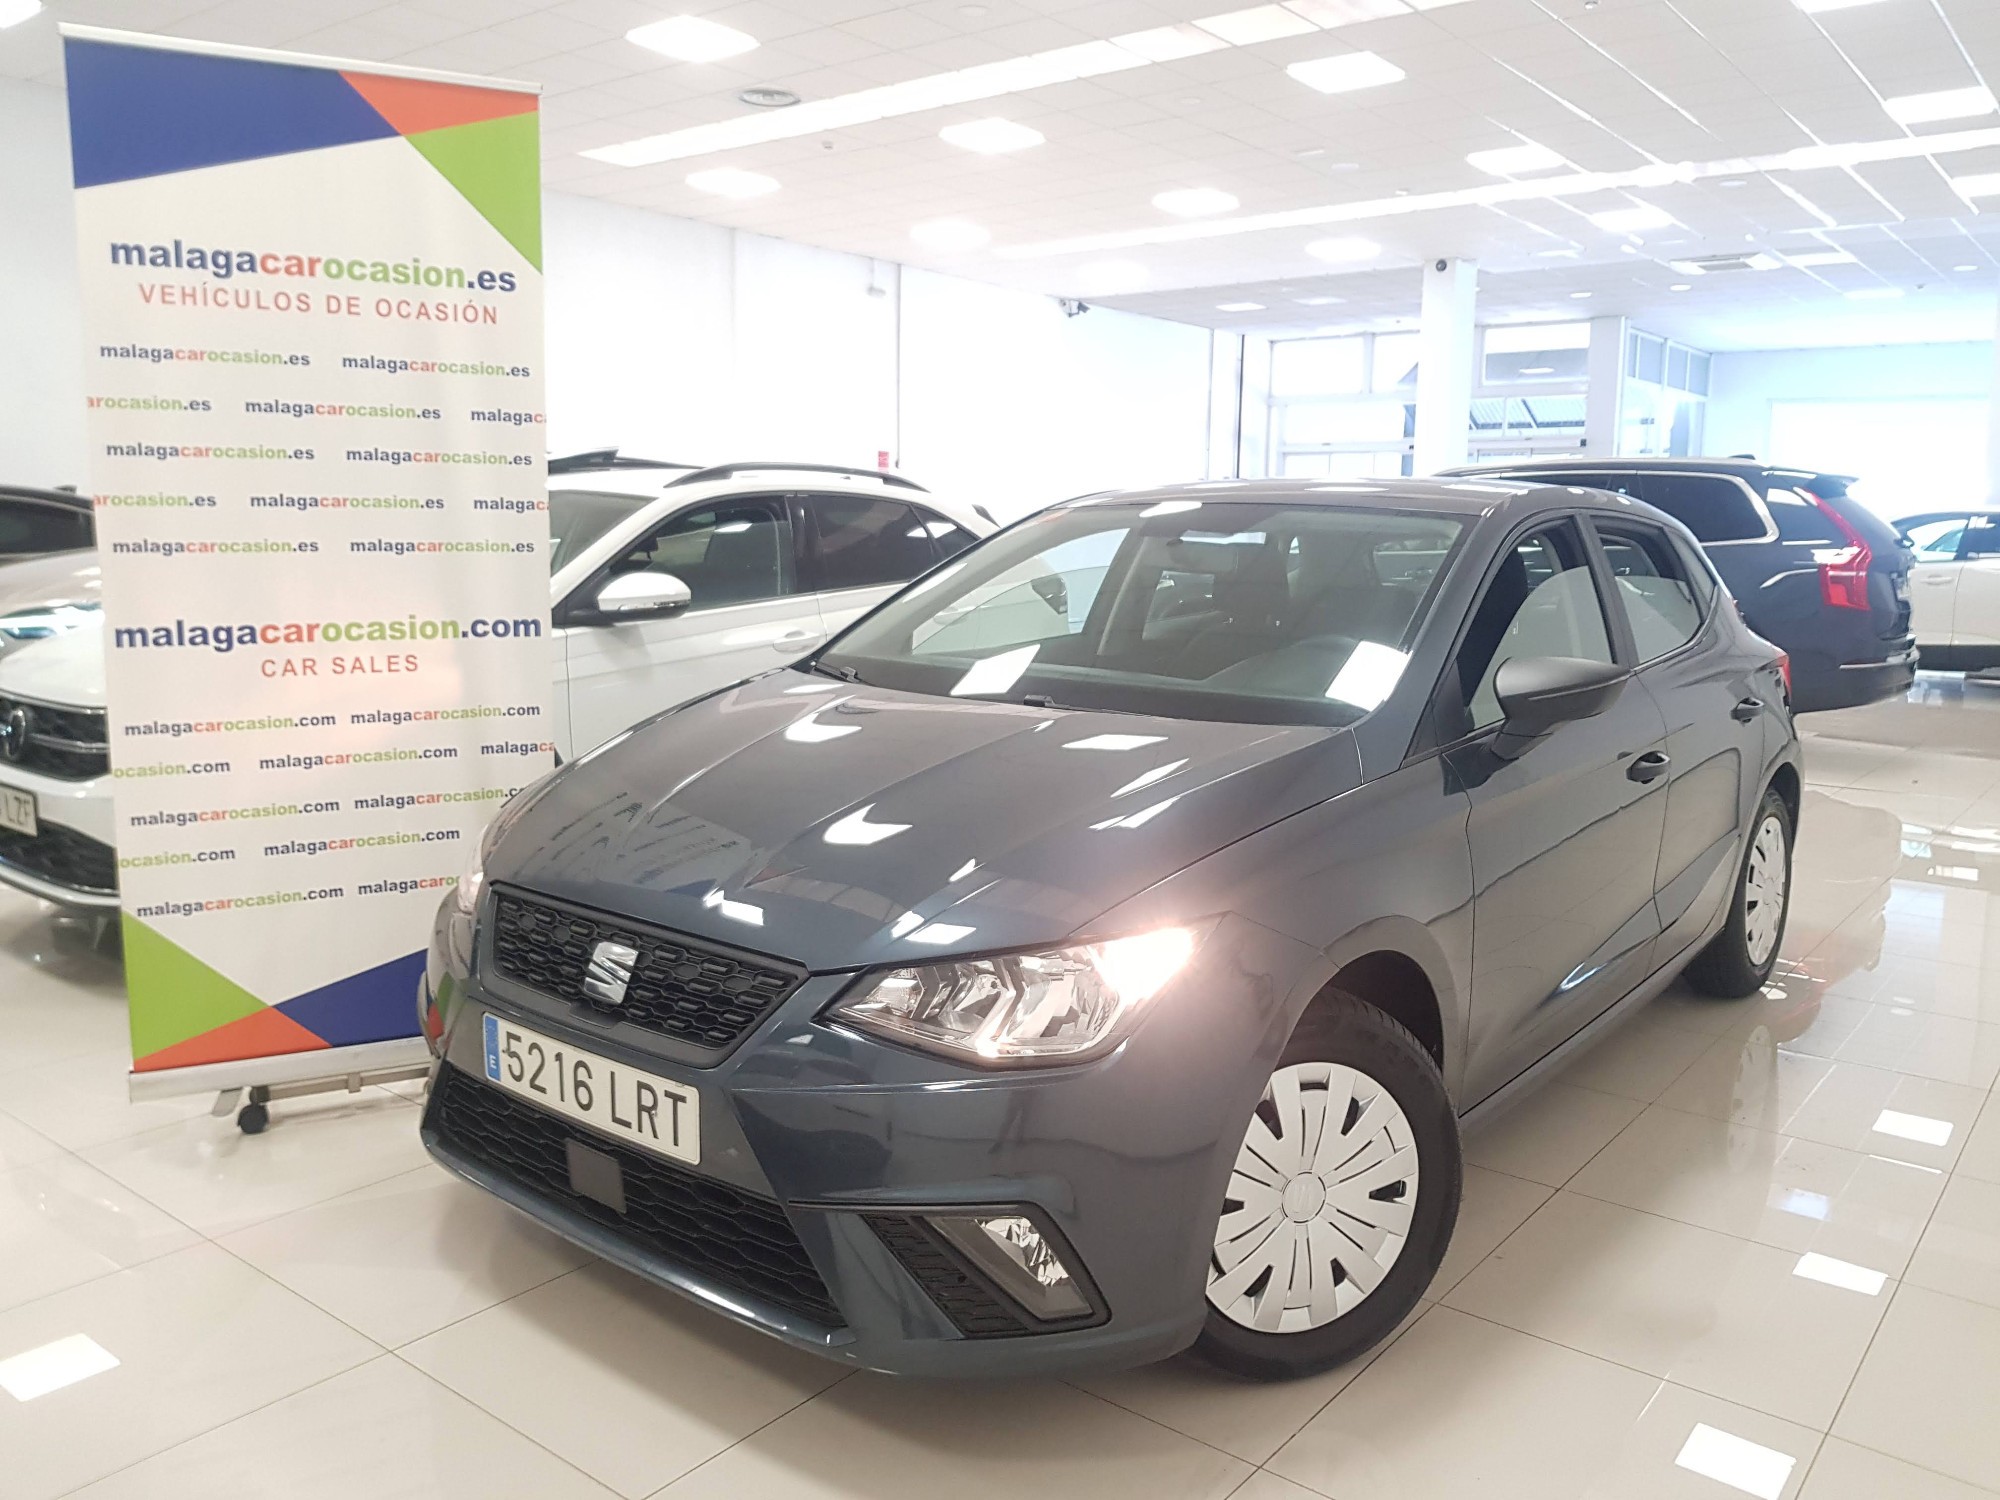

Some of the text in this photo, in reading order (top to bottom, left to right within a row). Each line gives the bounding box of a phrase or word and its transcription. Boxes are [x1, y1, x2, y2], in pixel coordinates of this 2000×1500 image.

[110, 239, 517, 292] malagacarocasion.es
[139, 281, 496, 324] VEHÍCULOS DE OCASIÓN
[100, 344, 310, 366] malagacarocasion.es
[342, 355, 530, 377] malagacarocasion.es
[245, 399, 441, 419] malagacarocasion.es
[471, 408, 546, 426] malagac
[106, 442, 315, 461] malagacarocasion.es
[346, 447, 532, 466] malagacarocasion.es
[250, 493, 444, 511] malagacarocasion.es
[473, 497, 548, 512] malagac
[112, 538, 319, 557] malagacarocasion.es
[350, 539, 534, 555] malagacarocasion.es
[115, 614, 541, 652] malagacarocasion.com
[261, 654, 418, 678] CAR SALES
[351, 705, 540, 725] malagacarocasion.com
[125, 716, 336, 737] malagacarocasion.com
[259, 748, 458, 770] malagacarocasion.com
[112, 762, 230, 778] ocasion.com
[354, 788, 521, 810] malagacarocasion.c
[131, 801, 340, 826] malagacarocasion.com
[264, 830, 460, 856] malagacarocasion.com
[120, 849, 235, 868] ocasion.com
[136, 888, 344, 917] malagacarocasion.com
[489, 1054, 498, 1070] E
[504, 1030, 688, 1148] 5216 LRT
